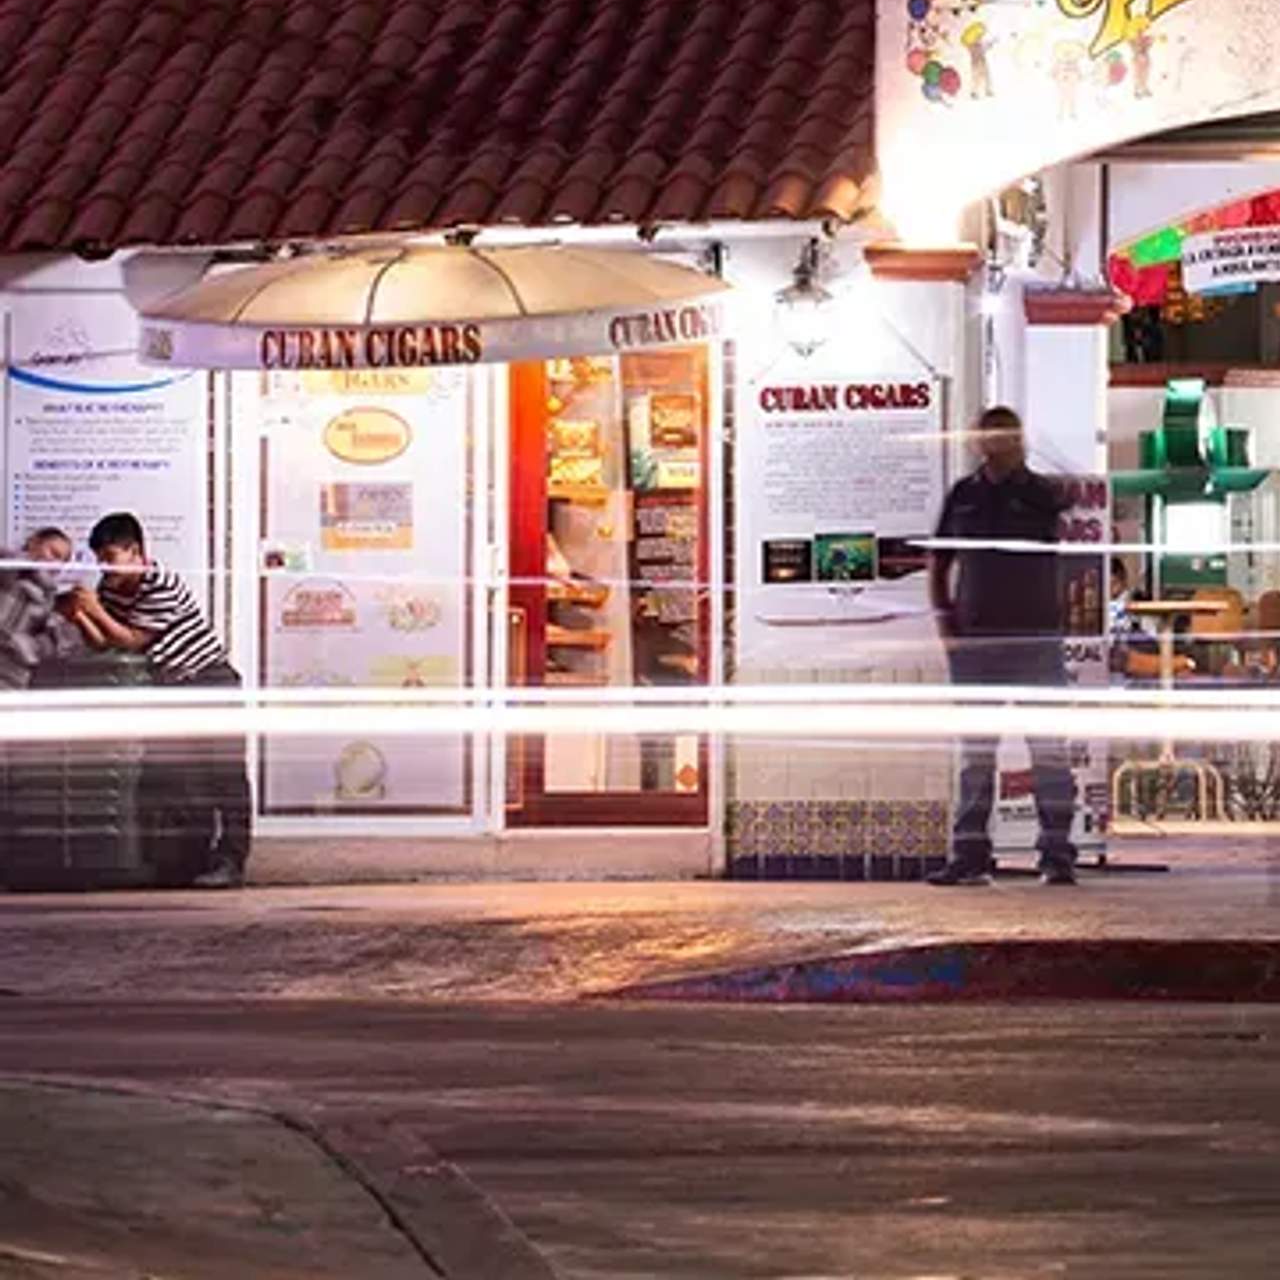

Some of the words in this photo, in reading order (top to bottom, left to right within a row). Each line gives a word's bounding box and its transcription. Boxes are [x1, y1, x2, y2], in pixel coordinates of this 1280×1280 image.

[260, 328, 355, 370] CUBAN
[364, 323, 483, 368] CIGARS
[609, 309, 677, 349] CUBAN
[760, 385, 838, 413] CUBAN
[844, 382, 931, 411] CIGARS
